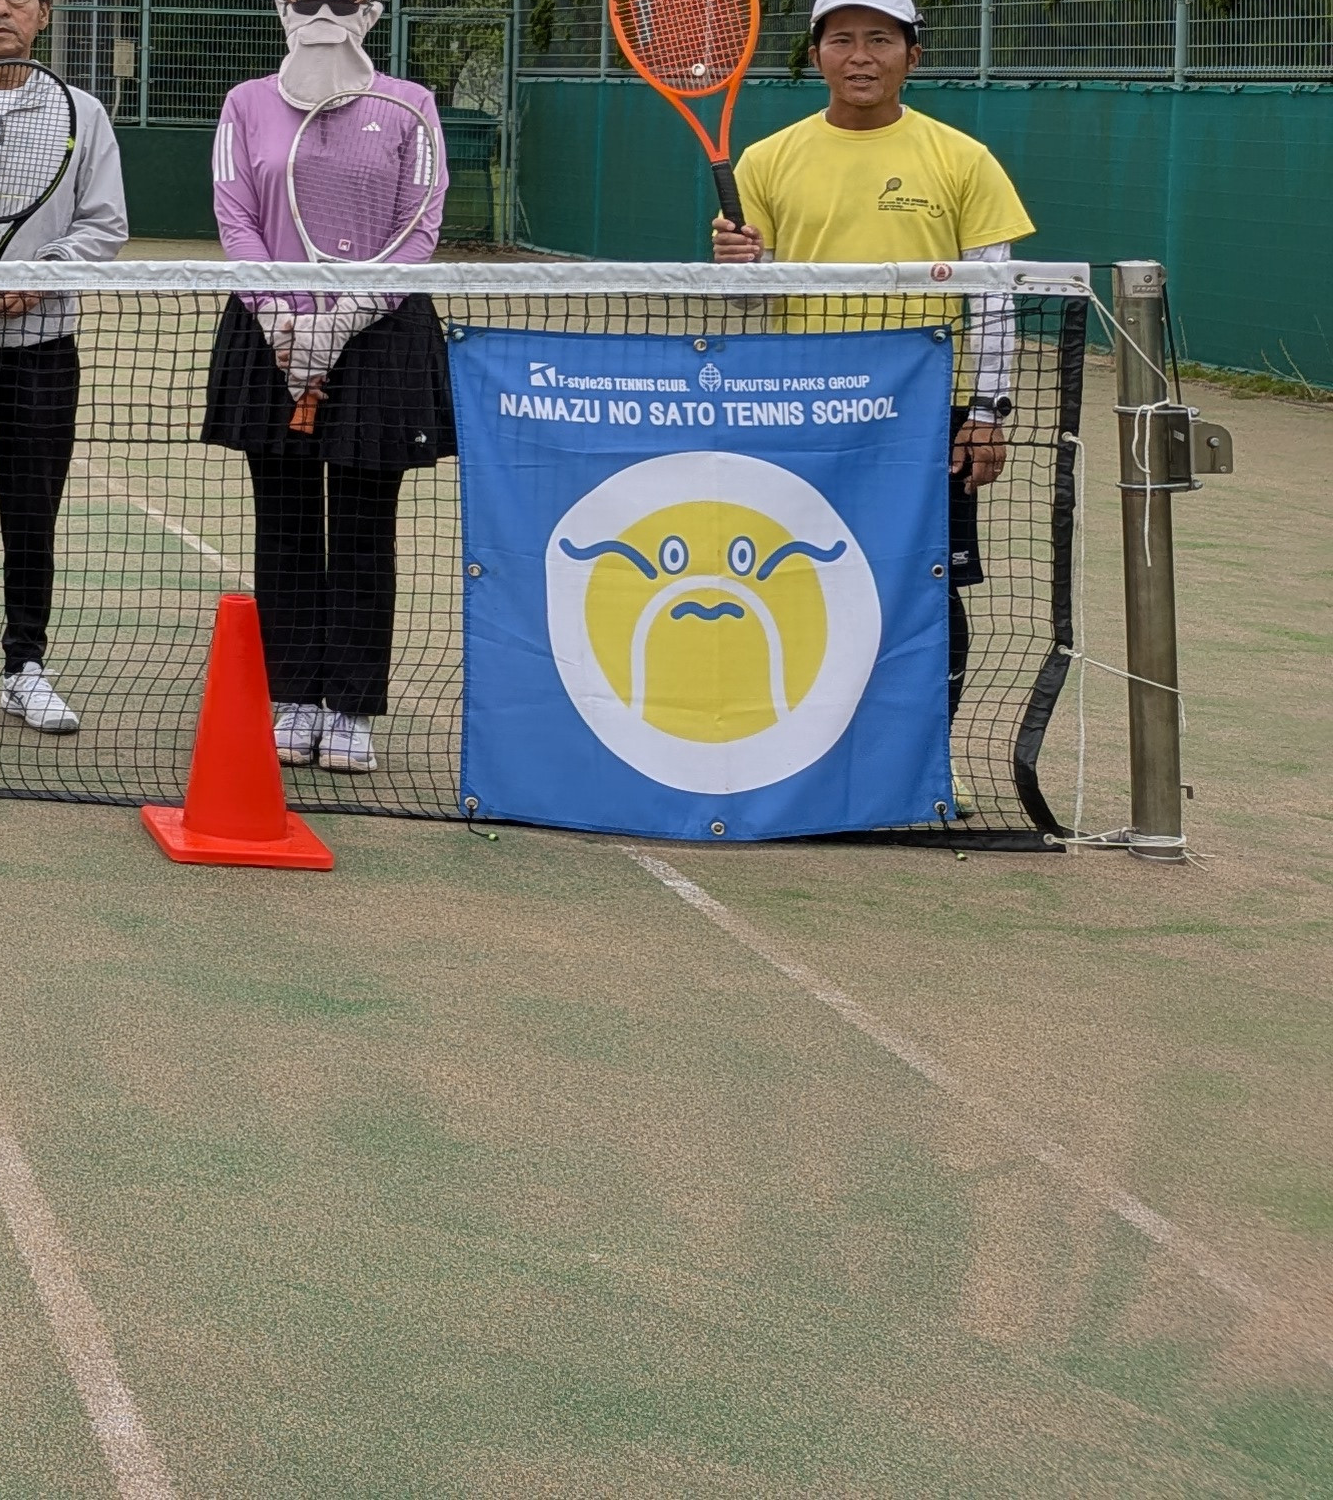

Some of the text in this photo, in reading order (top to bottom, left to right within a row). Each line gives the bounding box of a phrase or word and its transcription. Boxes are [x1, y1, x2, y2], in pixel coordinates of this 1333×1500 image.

[557, 375, 690, 392] T-style26 TENNIS CLUB.
[724, 375, 870, 392] FUKUTSU PARKS GROUP
[500, 393, 898, 426] NAMAZU NO SATO TENNIS SCHOOL
